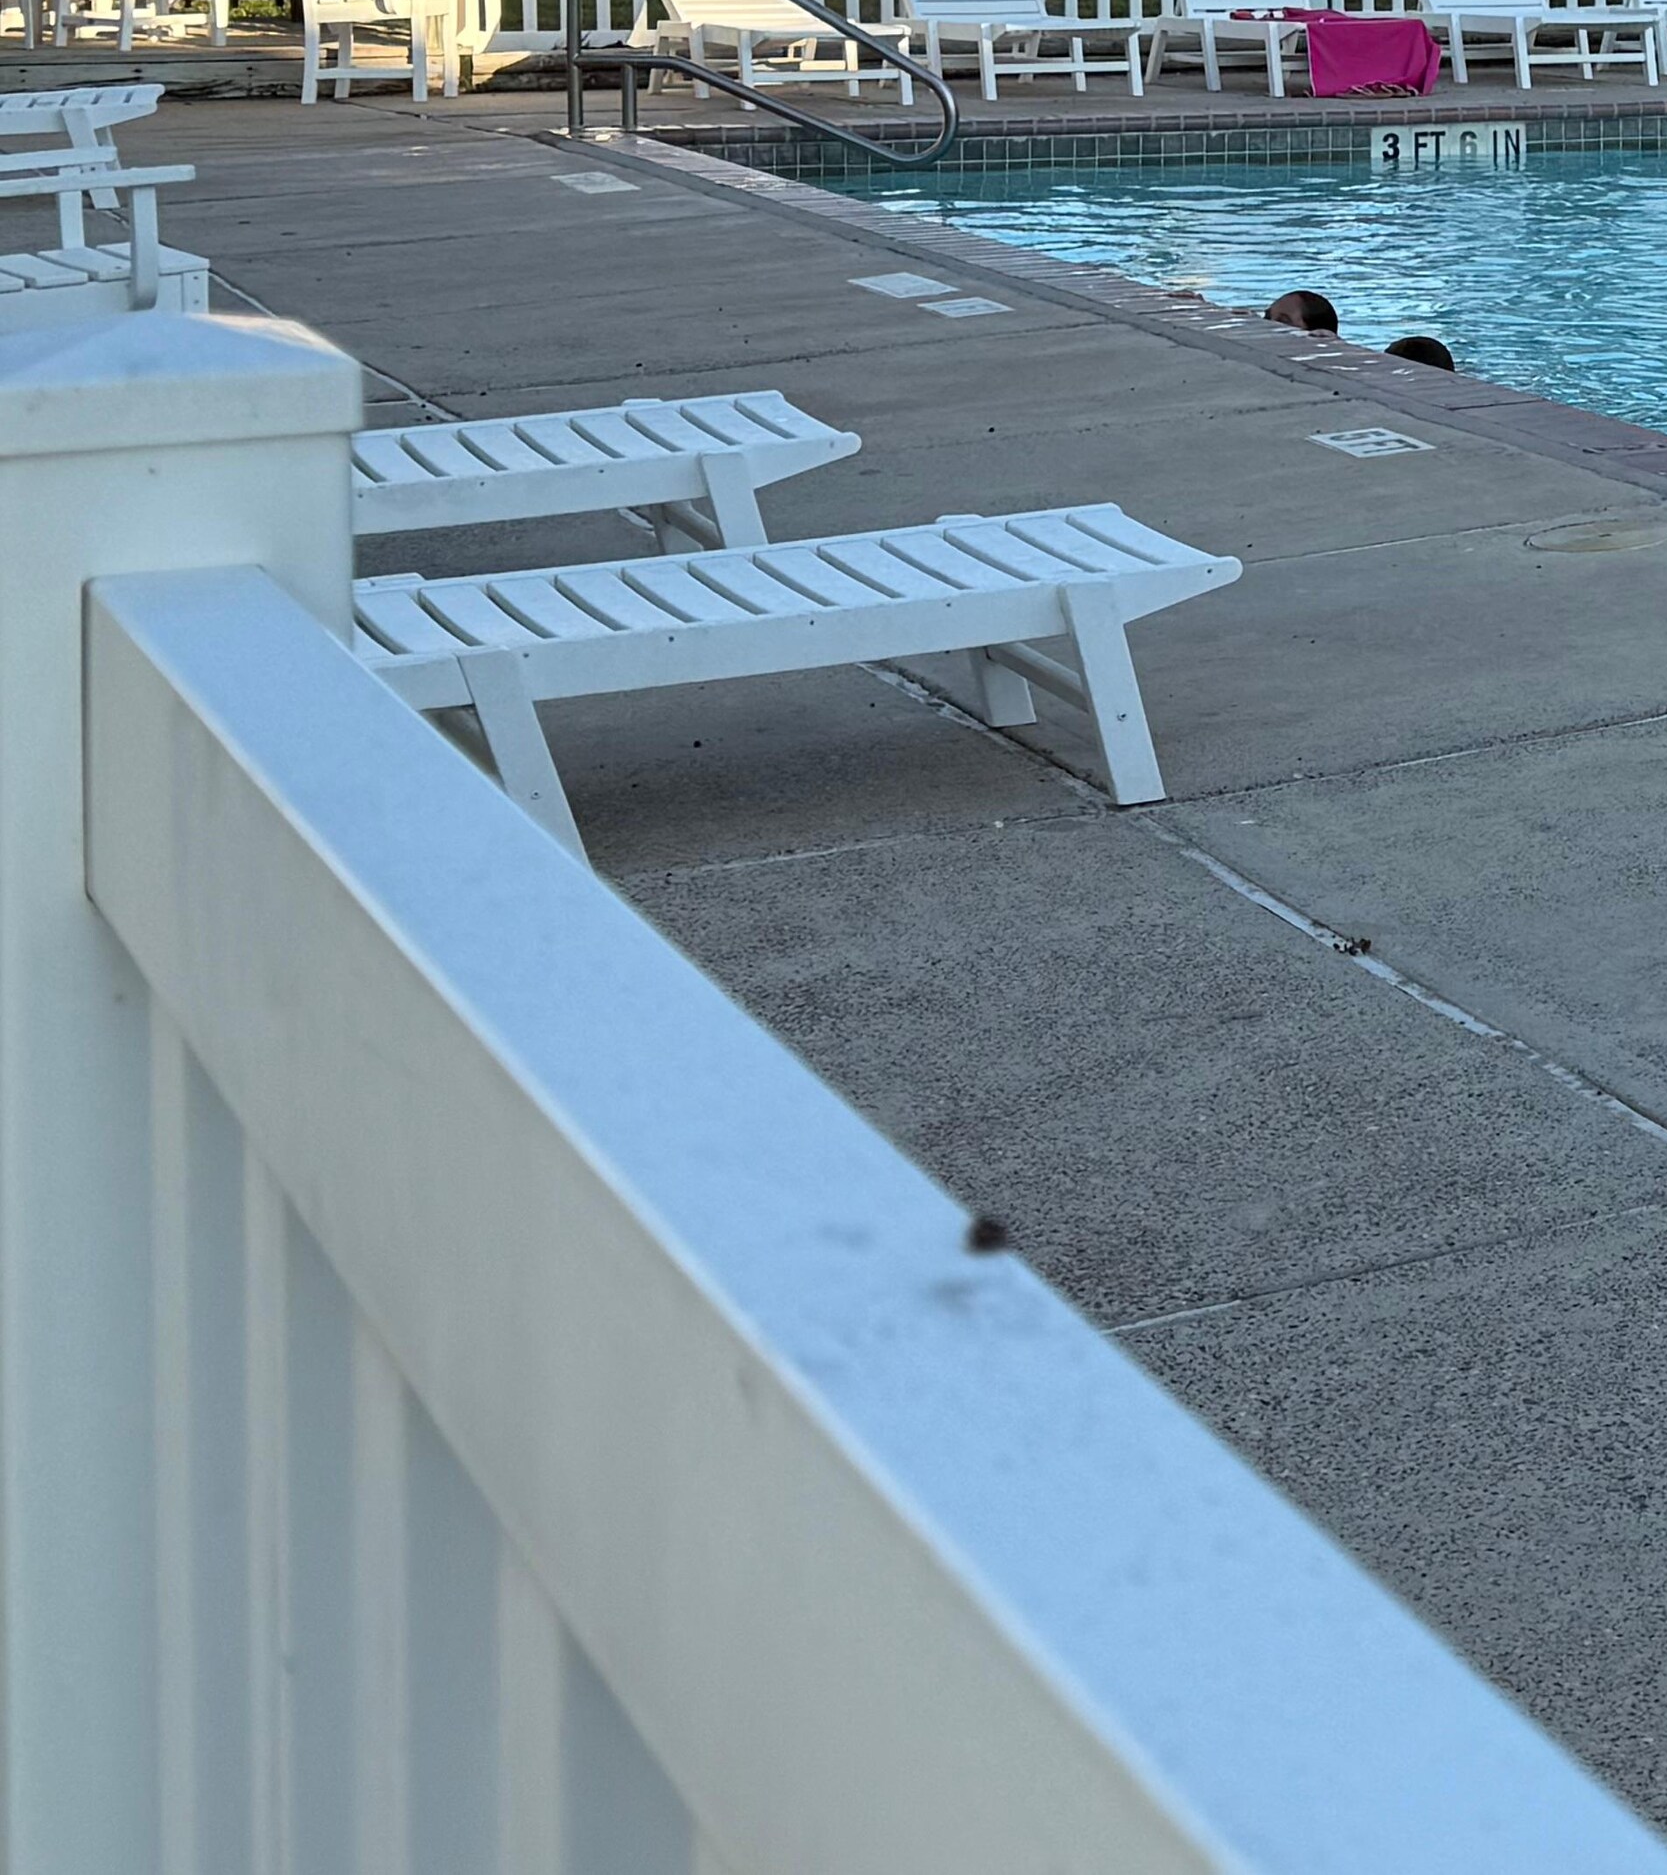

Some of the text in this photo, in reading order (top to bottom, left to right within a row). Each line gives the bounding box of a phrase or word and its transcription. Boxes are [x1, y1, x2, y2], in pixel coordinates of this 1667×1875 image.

[1382, 129, 1520, 170] 3 FT 6 IN
